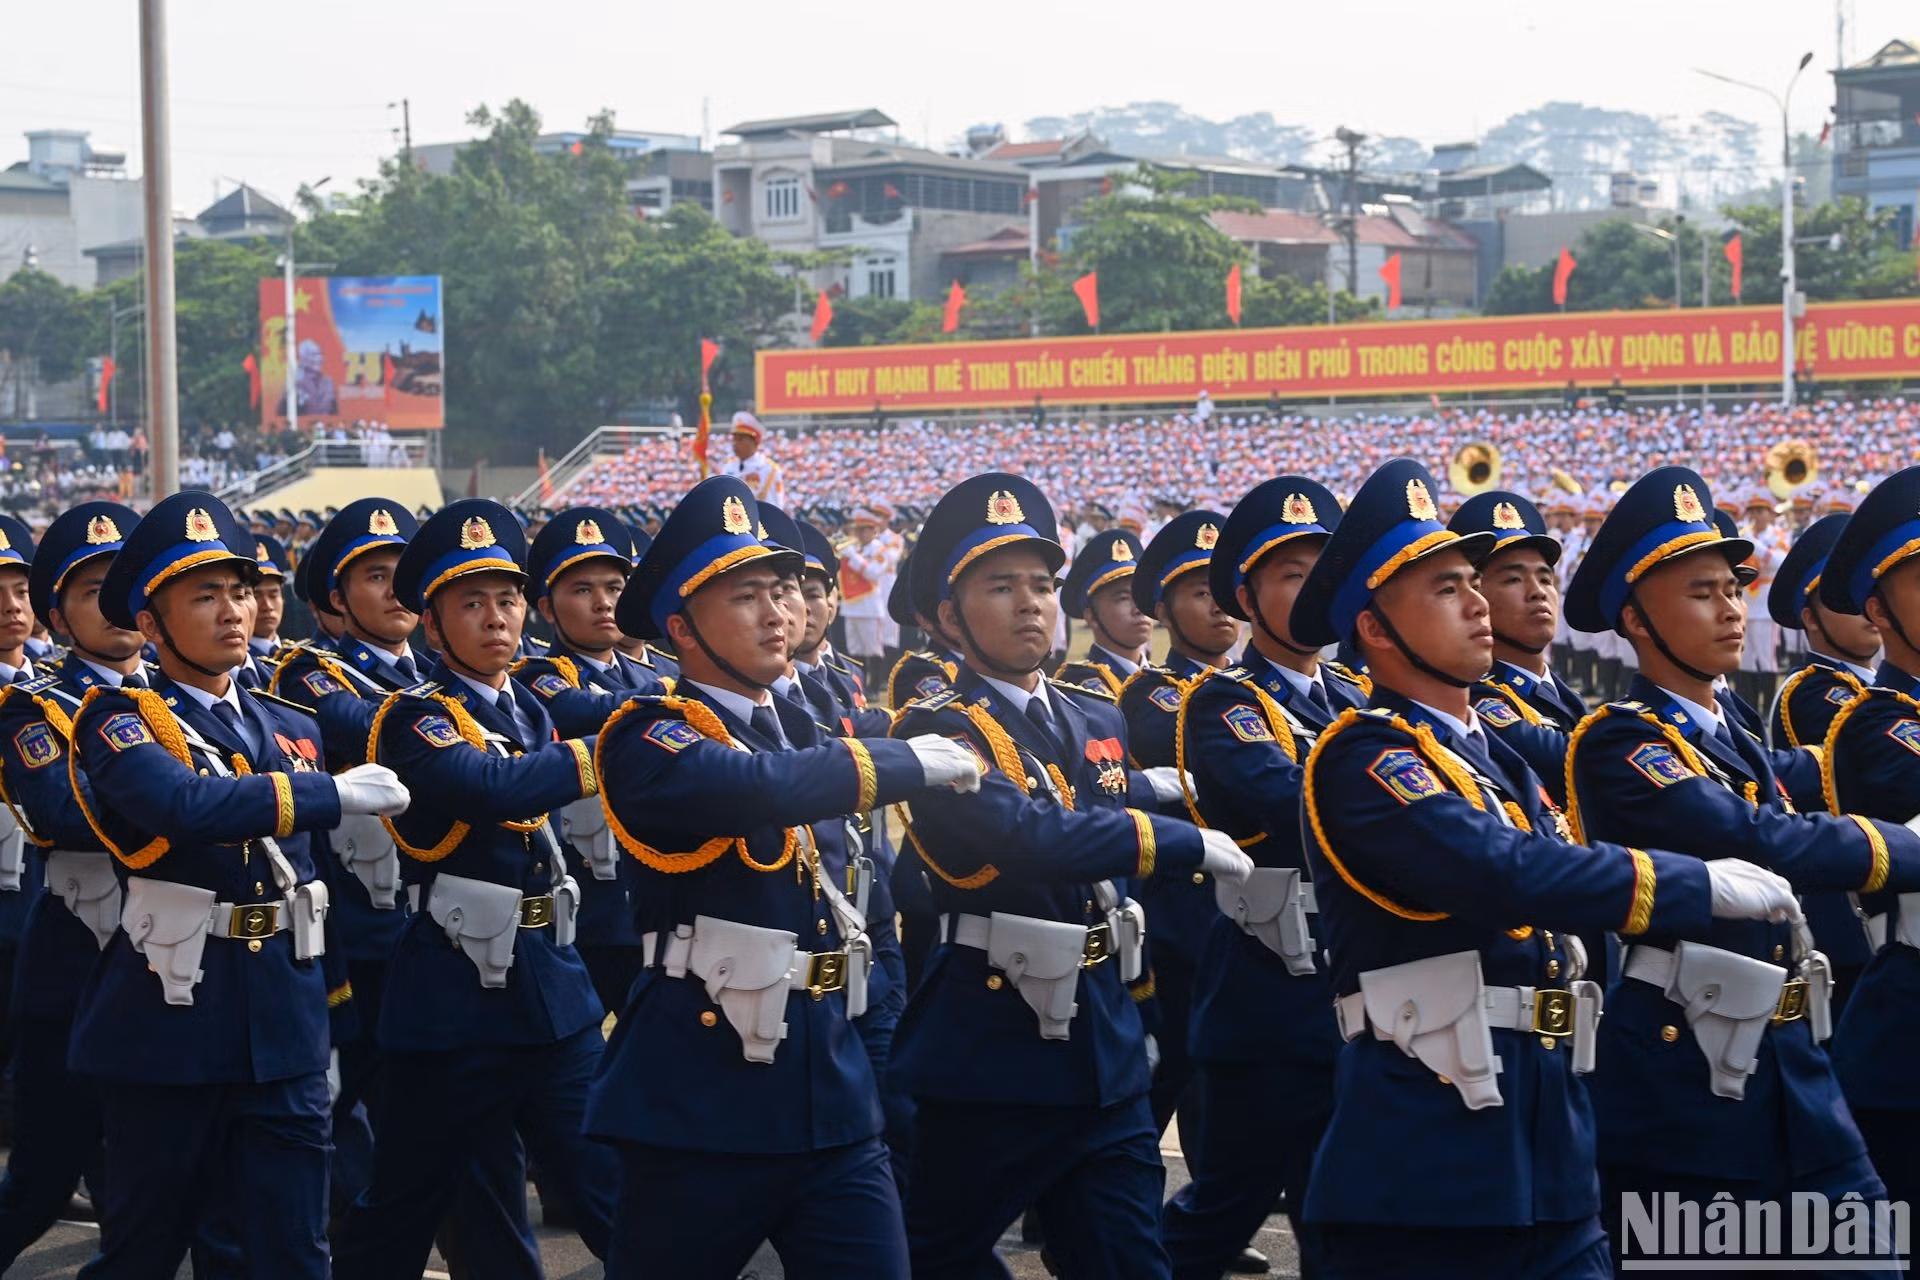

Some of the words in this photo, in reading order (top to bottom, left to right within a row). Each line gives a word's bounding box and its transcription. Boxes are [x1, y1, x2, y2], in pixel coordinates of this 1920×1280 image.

[785, 364, 830, 398] PHÁT
[834, 367, 870, 397] HUY
[875, 365, 929, 400] MẠNH
[968, 362, 1010, 390] TINH
[1069, 347, 1127, 388] CHIẾN
[1132, 344, 1196, 385] THẮNG
[1201, 346, 1248, 389] ĐIỆN
[1254, 343, 1302, 381] BIÊN
[1307, 337, 1351, 379] PHỦ
[1357, 342, 1430, 377] TRONG
[1436, 335, 1498, 374] CÔNG
[1503, 331, 1563, 377] CUỘC
[1569, 329, 1615, 369] XÂY
[1621, 329, 1686, 374] DỰNG
[1692, 325, 1724, 366] VÀ
[1730, 320, 1780, 364] BẢO
[1826, 320, 1895, 361] VỮNG
